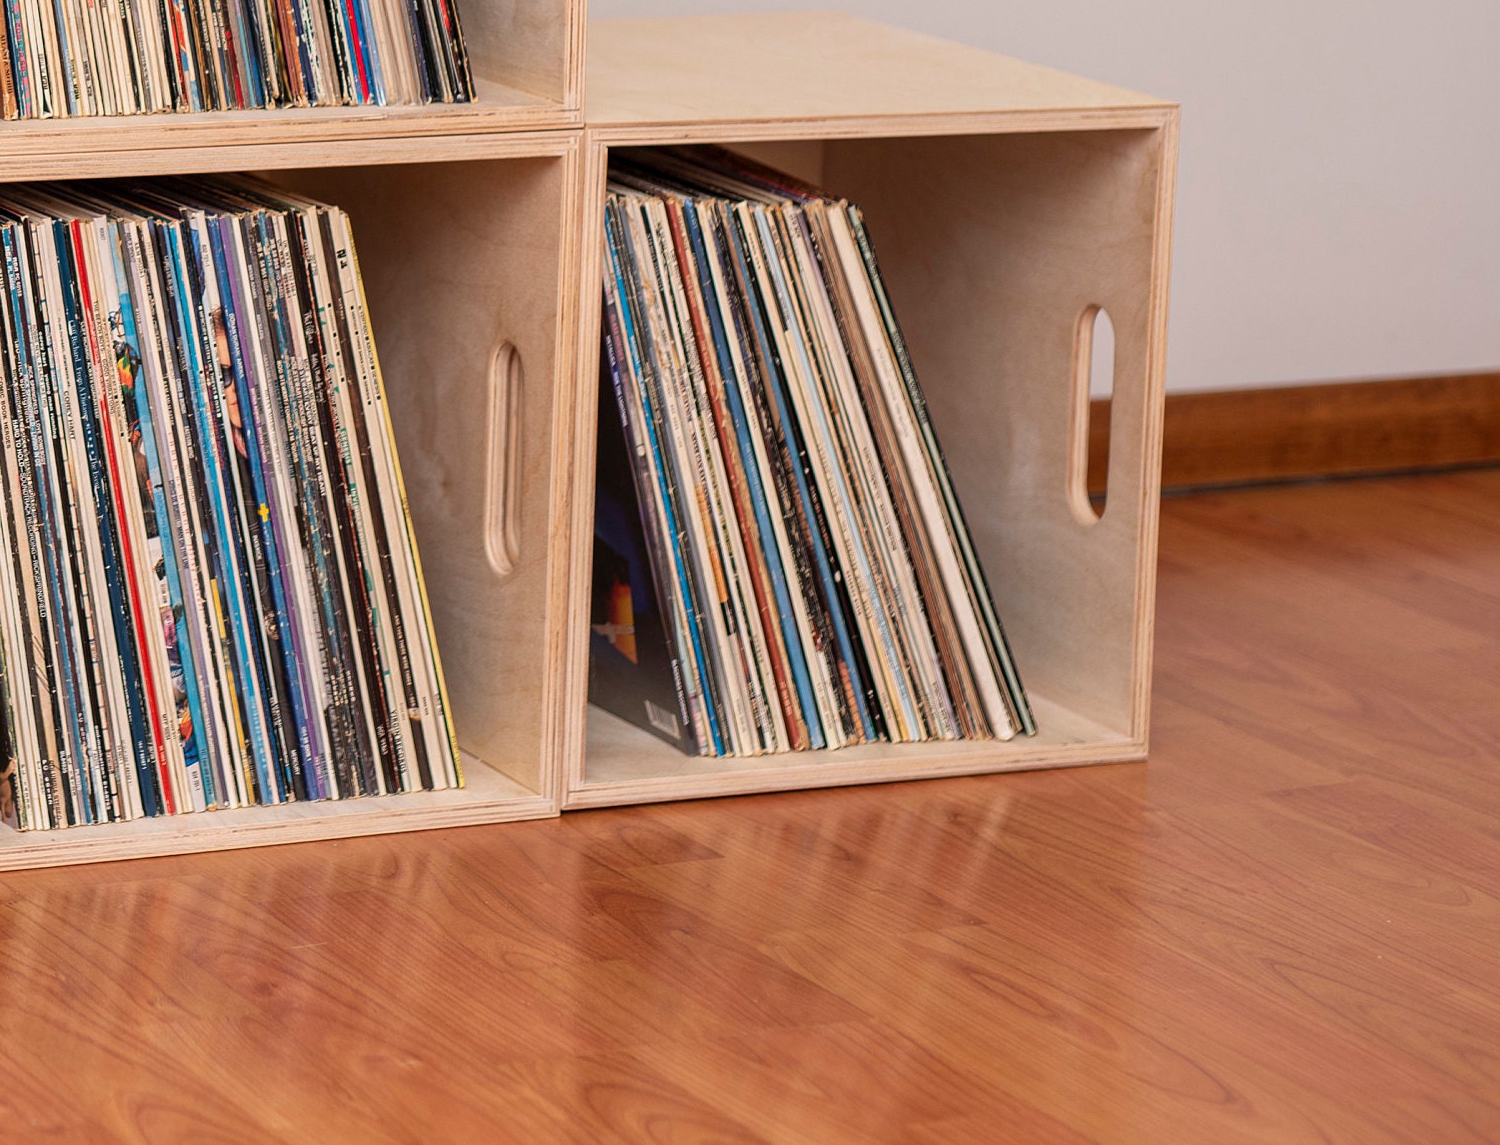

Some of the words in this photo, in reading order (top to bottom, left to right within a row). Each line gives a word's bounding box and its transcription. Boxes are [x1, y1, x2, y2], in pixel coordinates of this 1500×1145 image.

[0, 401, 8, 420] BOOK
[64, 391, 72, 418] COREY
[68, 420, 76, 440] HART
[3, 422, 11, 449] HEROES
[390, 710, 401, 736] VIRGIN
[290, 749, 300, 776] MERCURY
[395, 736, 407, 774] RECORDS
